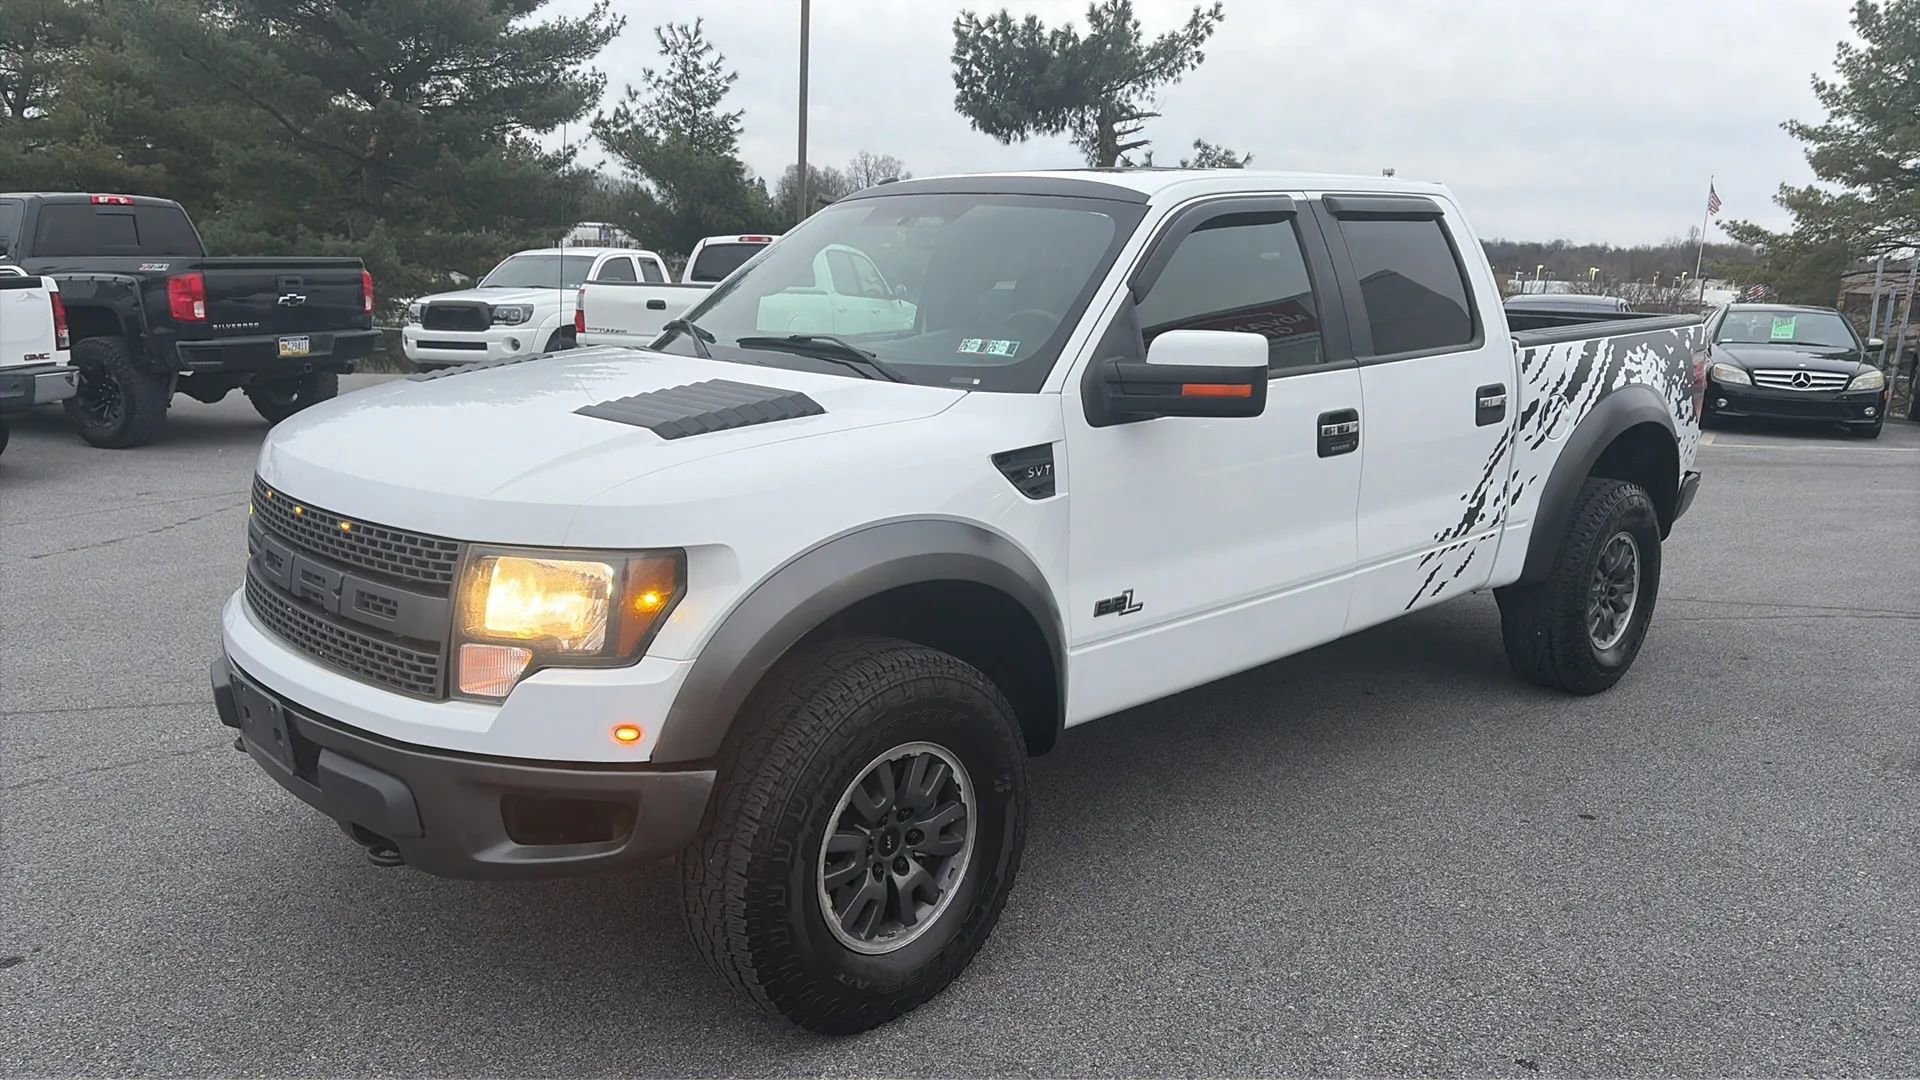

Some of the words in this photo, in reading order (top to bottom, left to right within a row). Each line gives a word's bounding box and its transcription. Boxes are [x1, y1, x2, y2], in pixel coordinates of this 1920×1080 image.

[213, 322, 260, 330] SILVERADO
[24, 353, 50, 361] GMC
[1028, 464, 1051, 478] SVT
